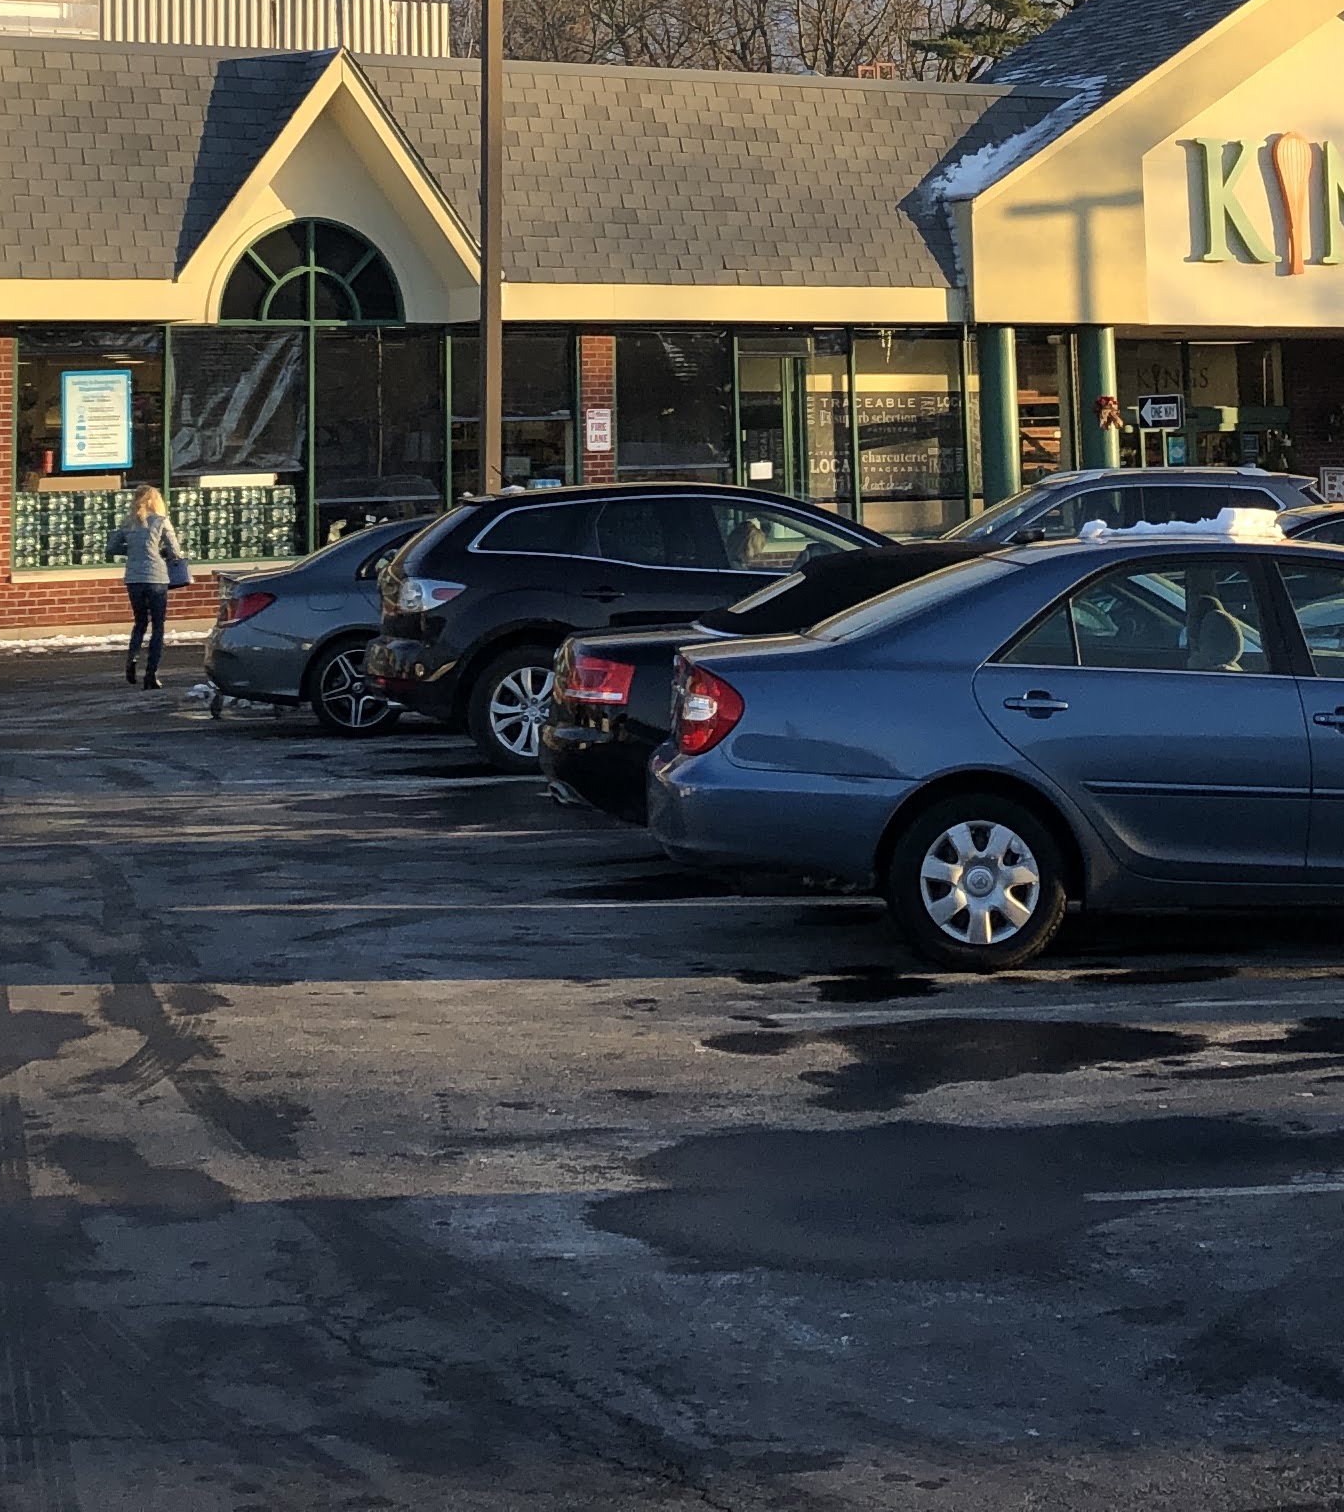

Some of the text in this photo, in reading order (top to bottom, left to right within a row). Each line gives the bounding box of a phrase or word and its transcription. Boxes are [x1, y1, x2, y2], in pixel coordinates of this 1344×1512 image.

[1151, 406, 1176, 418] ONE WAY
[833, 411, 869, 428] suprb
[590, 422, 607, 432] FIRE
[589, 434, 609, 444] LANE
[861, 451, 928, 464] charcuterie
[809, 458, 851, 474] LOCA
